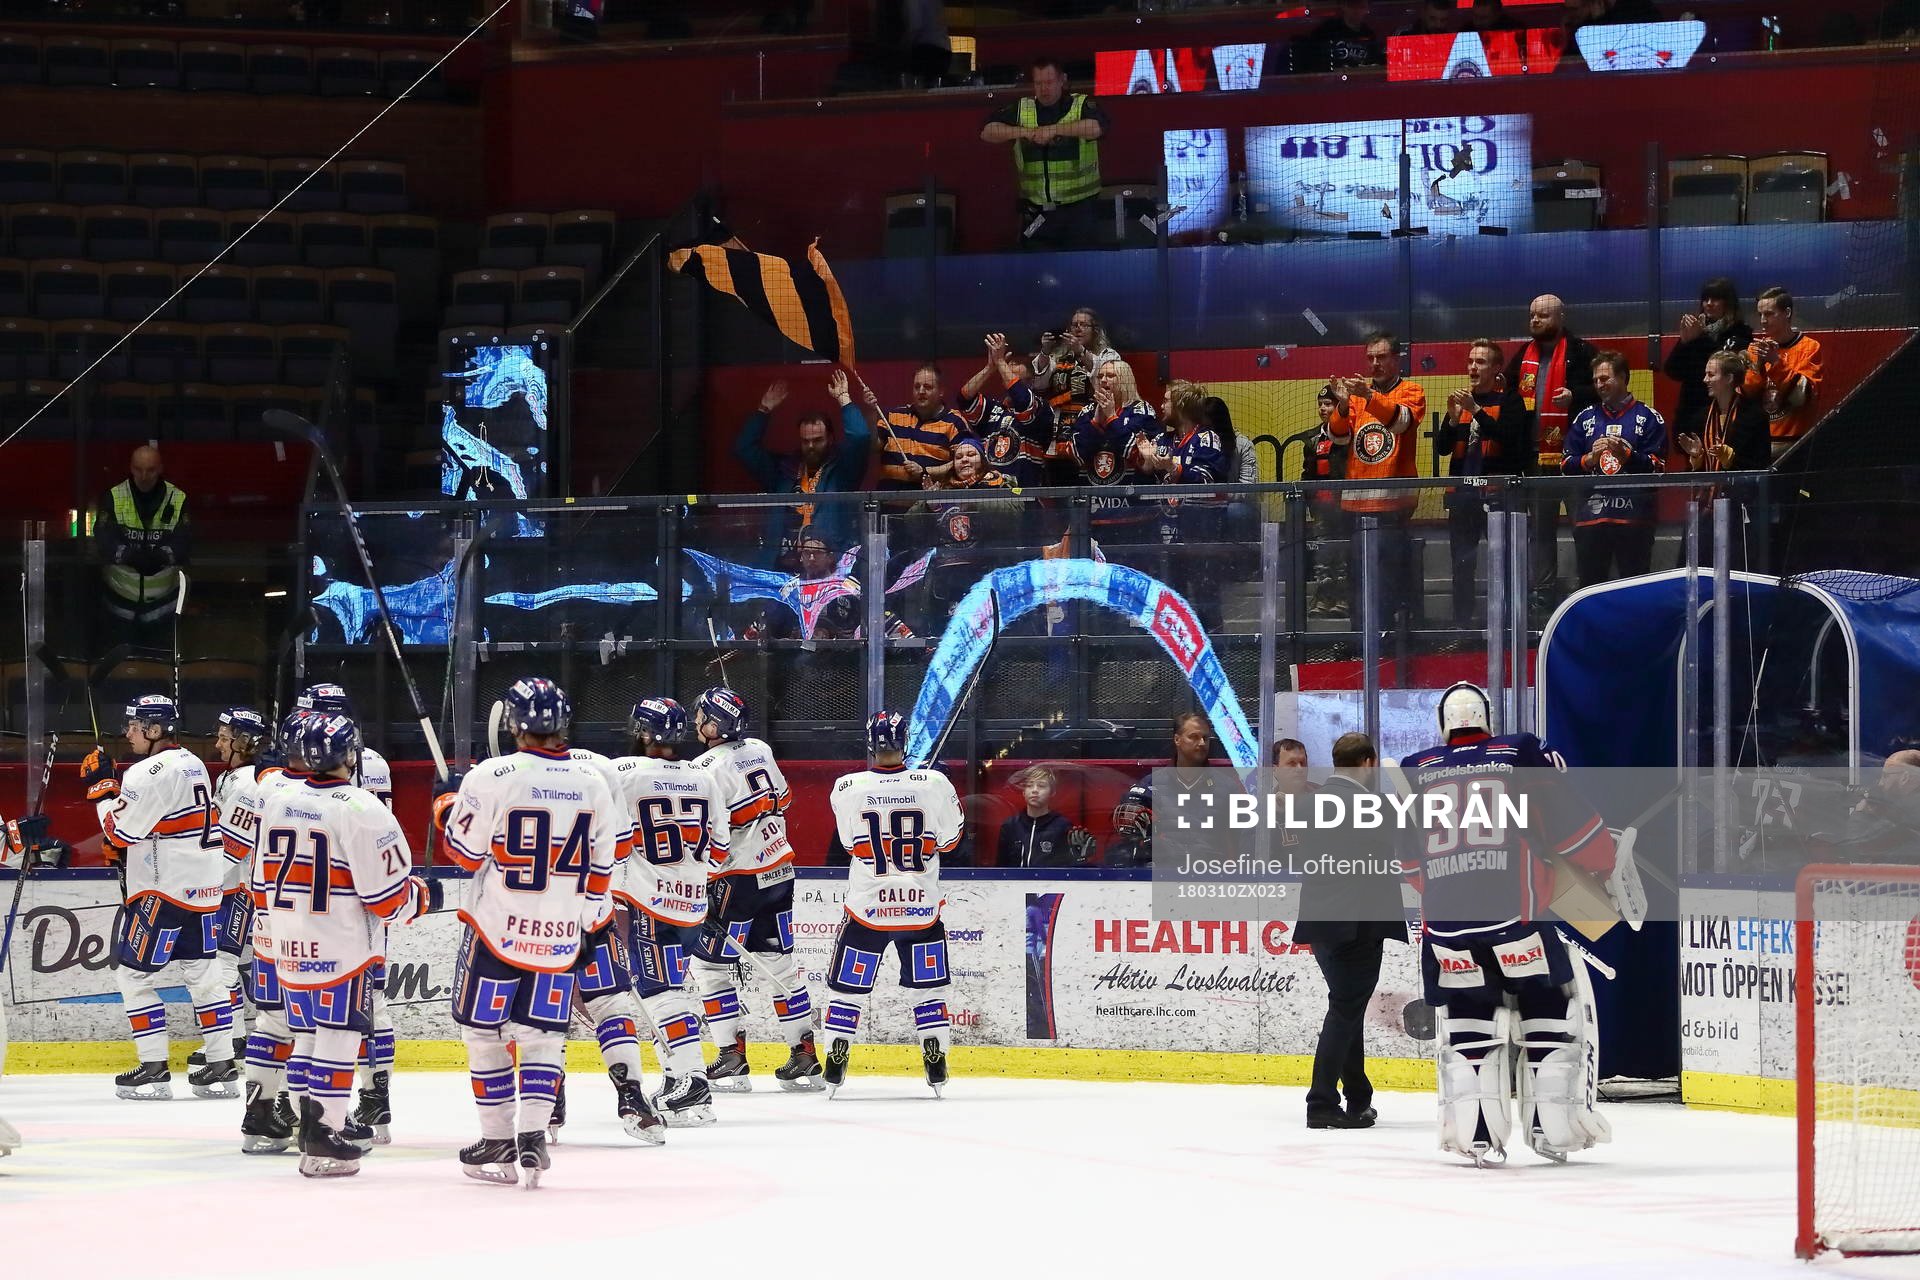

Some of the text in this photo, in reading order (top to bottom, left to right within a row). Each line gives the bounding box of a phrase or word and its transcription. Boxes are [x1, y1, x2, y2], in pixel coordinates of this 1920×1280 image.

[1098, 497, 1130, 509] VIDA
[1602, 497, 1633, 509] VIDA
[720, 700, 739, 716] VISMA
[148, 761, 164, 776] GBJ
[494, 763, 517, 778] GBJ
[617, 761, 637, 772] GBJ
[701, 755, 716, 769] GBJ
[909, 774, 928, 782] GBJ
[1418, 760, 1514, 785] Handelsbanken
[542, 788, 583, 801] Tillmobil
[661, 781, 698, 791] Tillmobil
[838, 779, 853, 792] GBJ
[112, 799, 128, 820] 2
[876, 795, 916, 805] Tillmobil
[194, 783, 225, 851] 2
[230, 806, 254, 832] 88
[457, 811, 476, 835] 4
[637, 796, 710, 865] 67
[503, 806, 596, 897] 94
[861, 808, 927, 877] 18
[381, 844, 409, 877] 21
[1426, 850, 1508, 881] JOHANSSON
[267, 826, 332, 915] 21
[805, 889, 823, 903] PÅ
[879, 888, 925, 903] CALOF
[877, 906, 935, 918] INTERSPORT
[231, 910, 243, 938] ALWEX
[1690, 915, 1732, 950] LIKA
[1094, 919, 1248, 954] HEALTH
[794, 947, 828, 955] MATERIAL
[278, 959, 337, 974] TERSPORT
[645, 946, 655, 976] ALWEX
[1094, 962, 1296, 993] Aktiv Livskvalitet
[1722, 957, 1784, 1003] ÖPPEN
[362, 977, 372, 1011] ALWEX
[947, 1008, 982, 1027] ndic
[1096, 1005, 1197, 1018] healthcare.lhc.com
